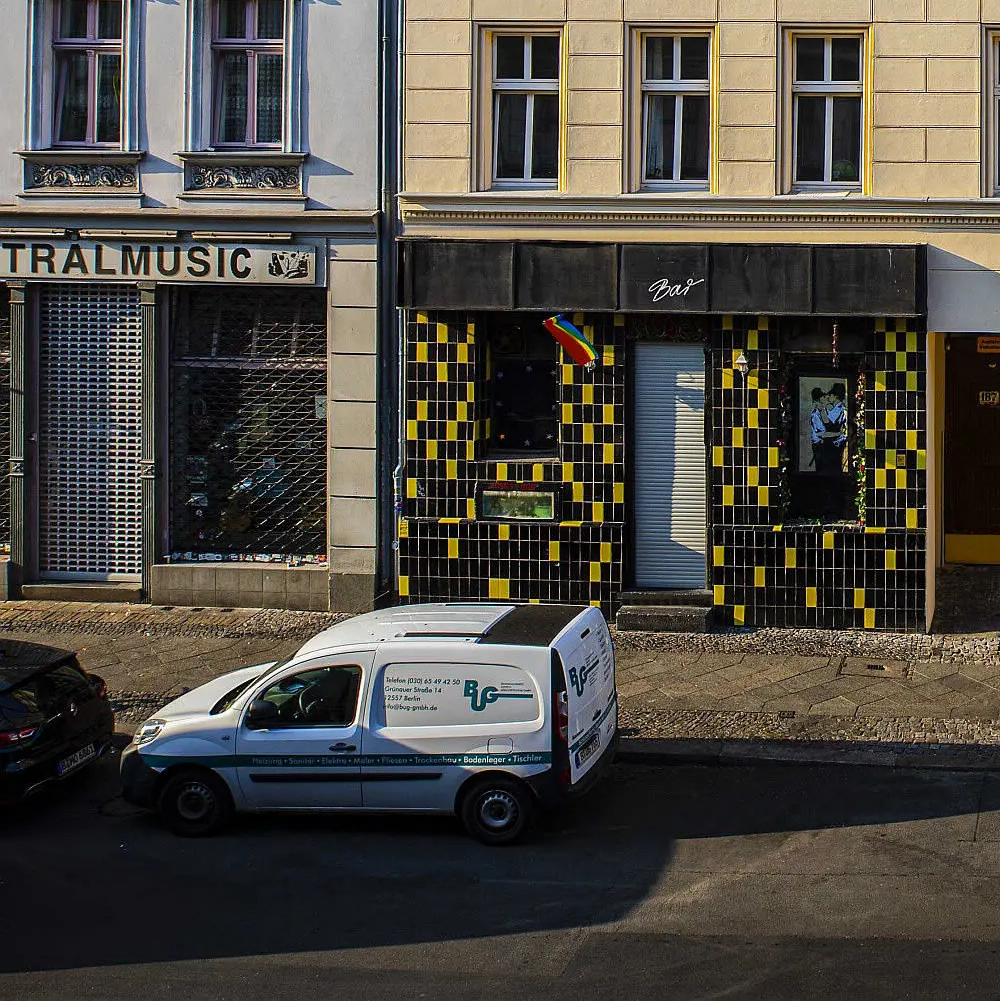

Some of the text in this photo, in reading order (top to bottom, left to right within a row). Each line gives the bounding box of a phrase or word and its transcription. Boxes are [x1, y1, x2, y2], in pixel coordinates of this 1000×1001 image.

[2, 242, 251, 279] TRALMUSIC
[648, 278, 705, 302] Bar
[981, 392, 997, 401] 187
[408, 677, 422, 685] (030)
[463, 755, 506, 764] Bodenleger
[512, 754, 542, 763] Tischler
